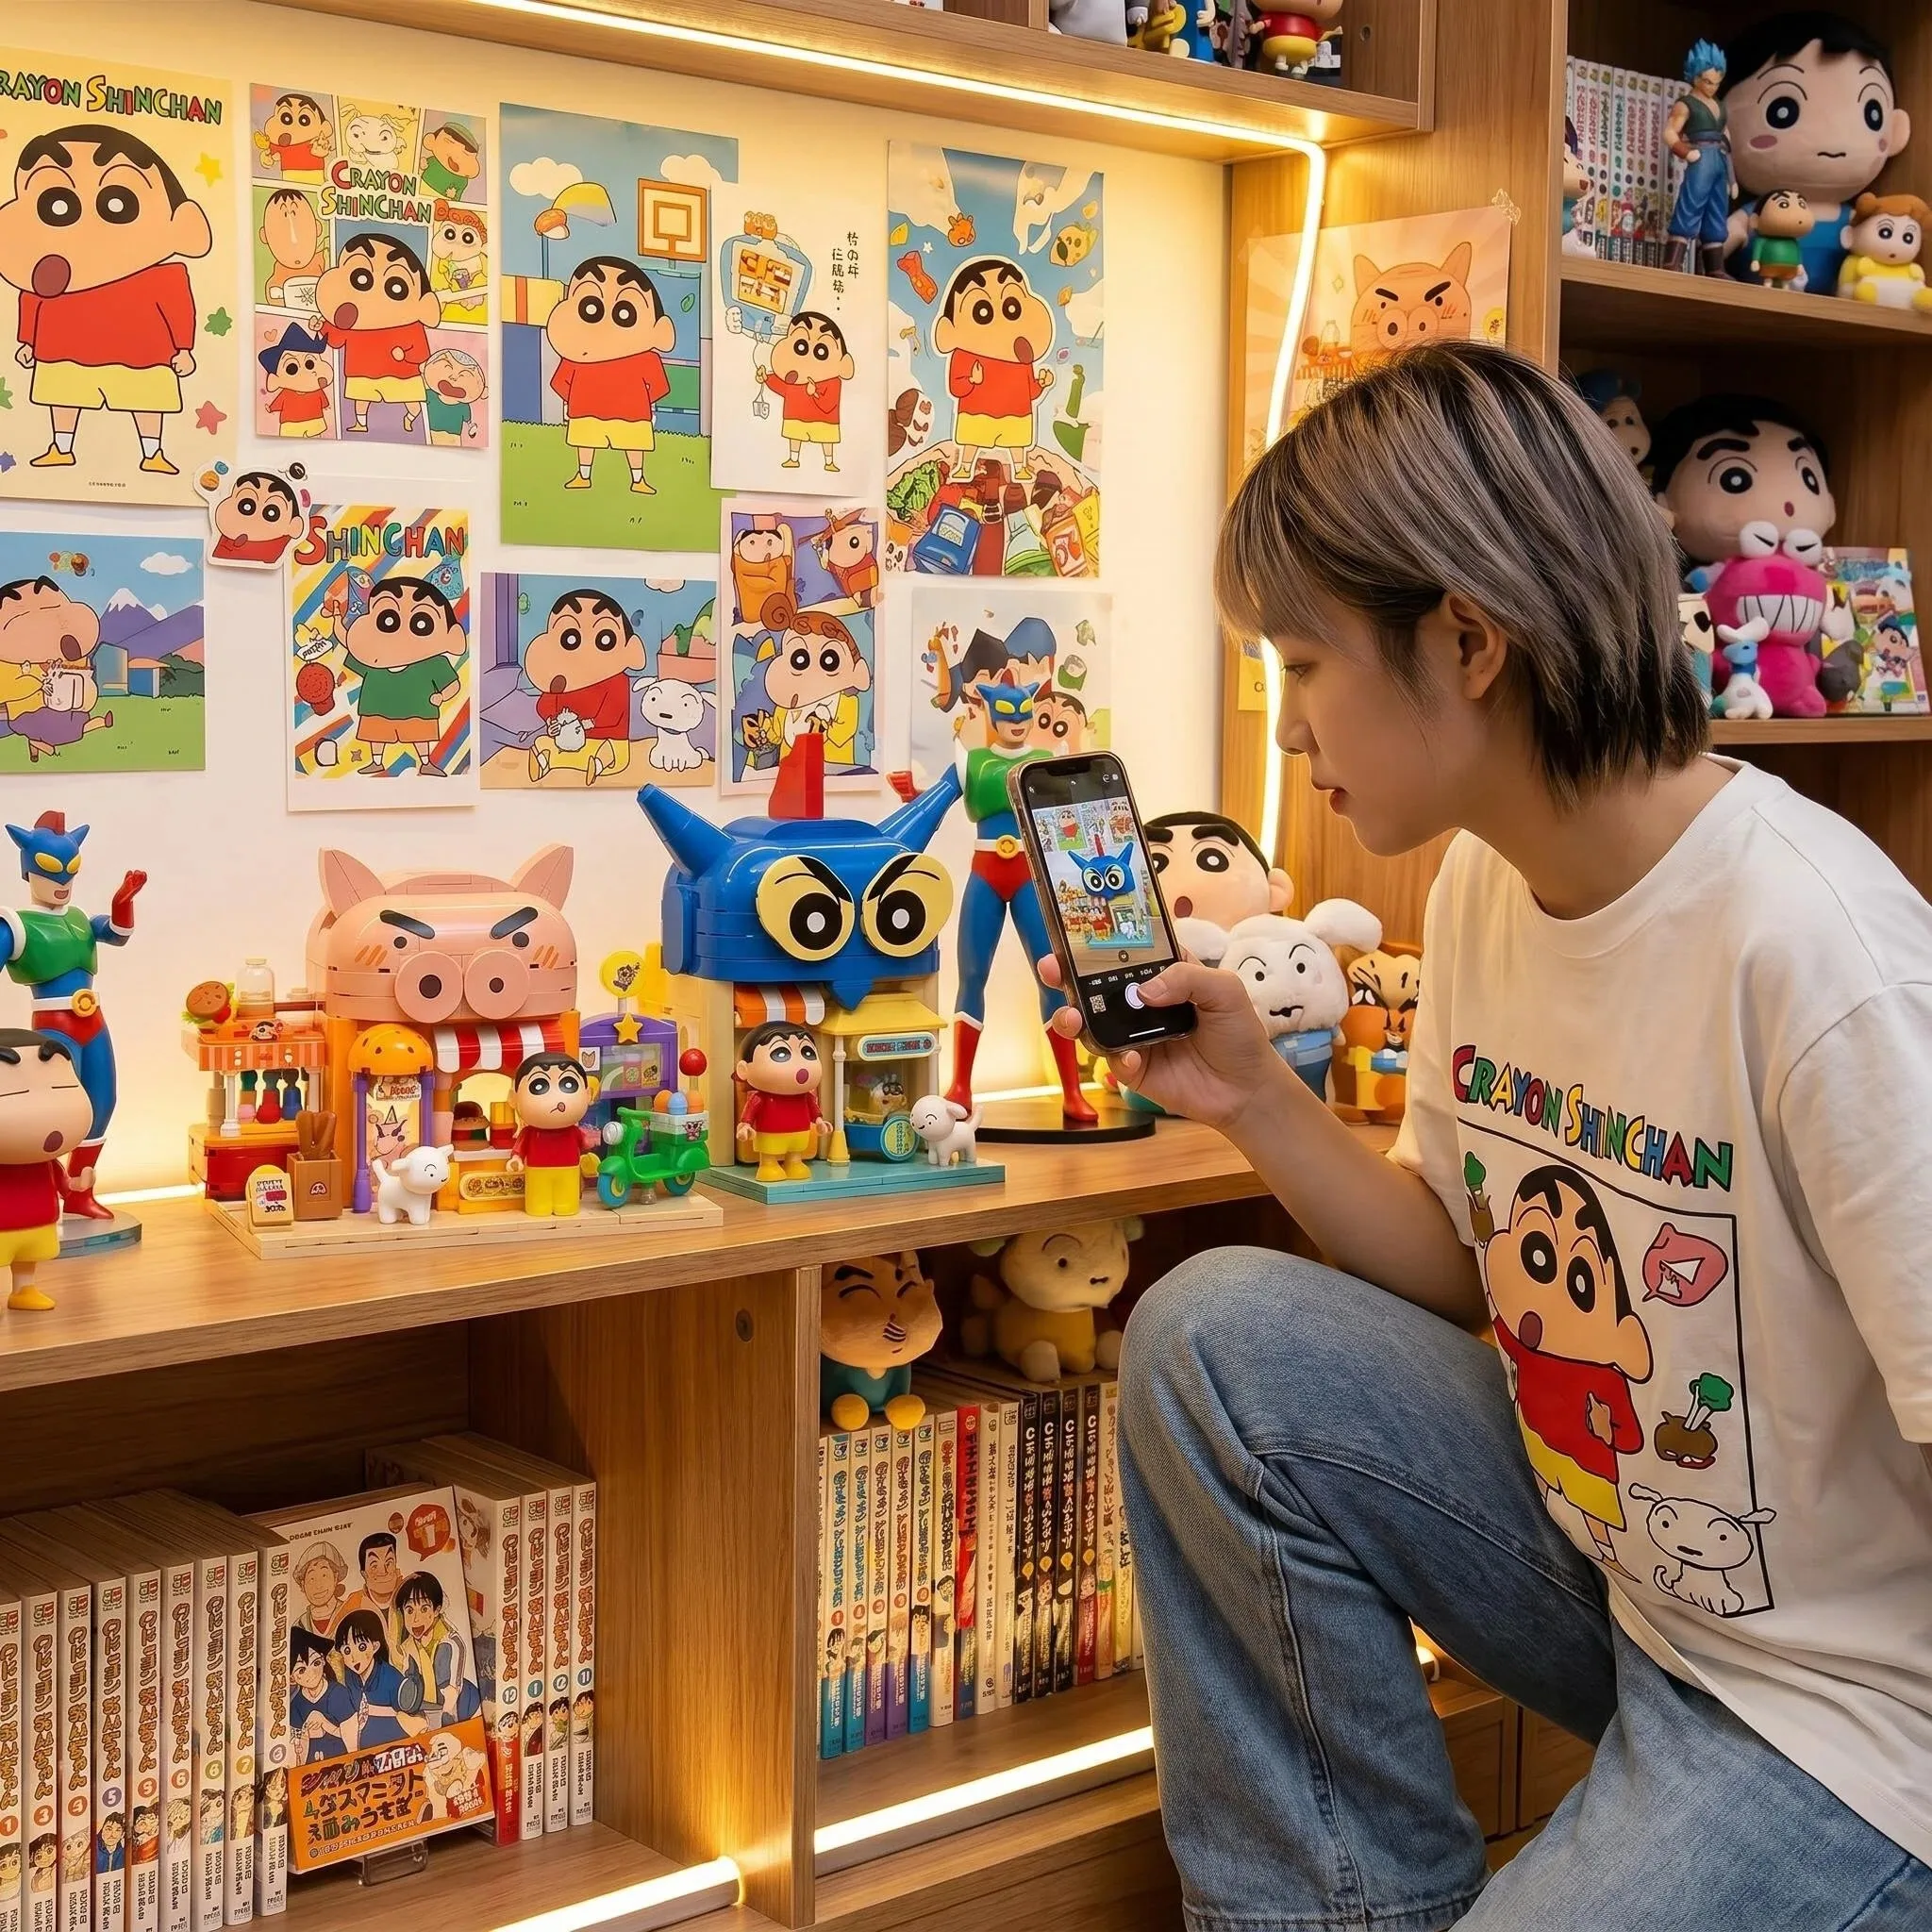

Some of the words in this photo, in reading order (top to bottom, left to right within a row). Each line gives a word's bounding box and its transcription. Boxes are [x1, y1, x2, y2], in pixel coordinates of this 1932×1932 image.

[86, 75, 223, 125] SHINCHAN
[330, 159, 417, 196] CRAYON
[321, 186, 432, 225] SHINCHAN
[293, 515, 465, 566] SHINCHAN
[1453, 1043, 1564, 1139] CRAYON
[1564, 1083, 1735, 1193] SHINCHAN
